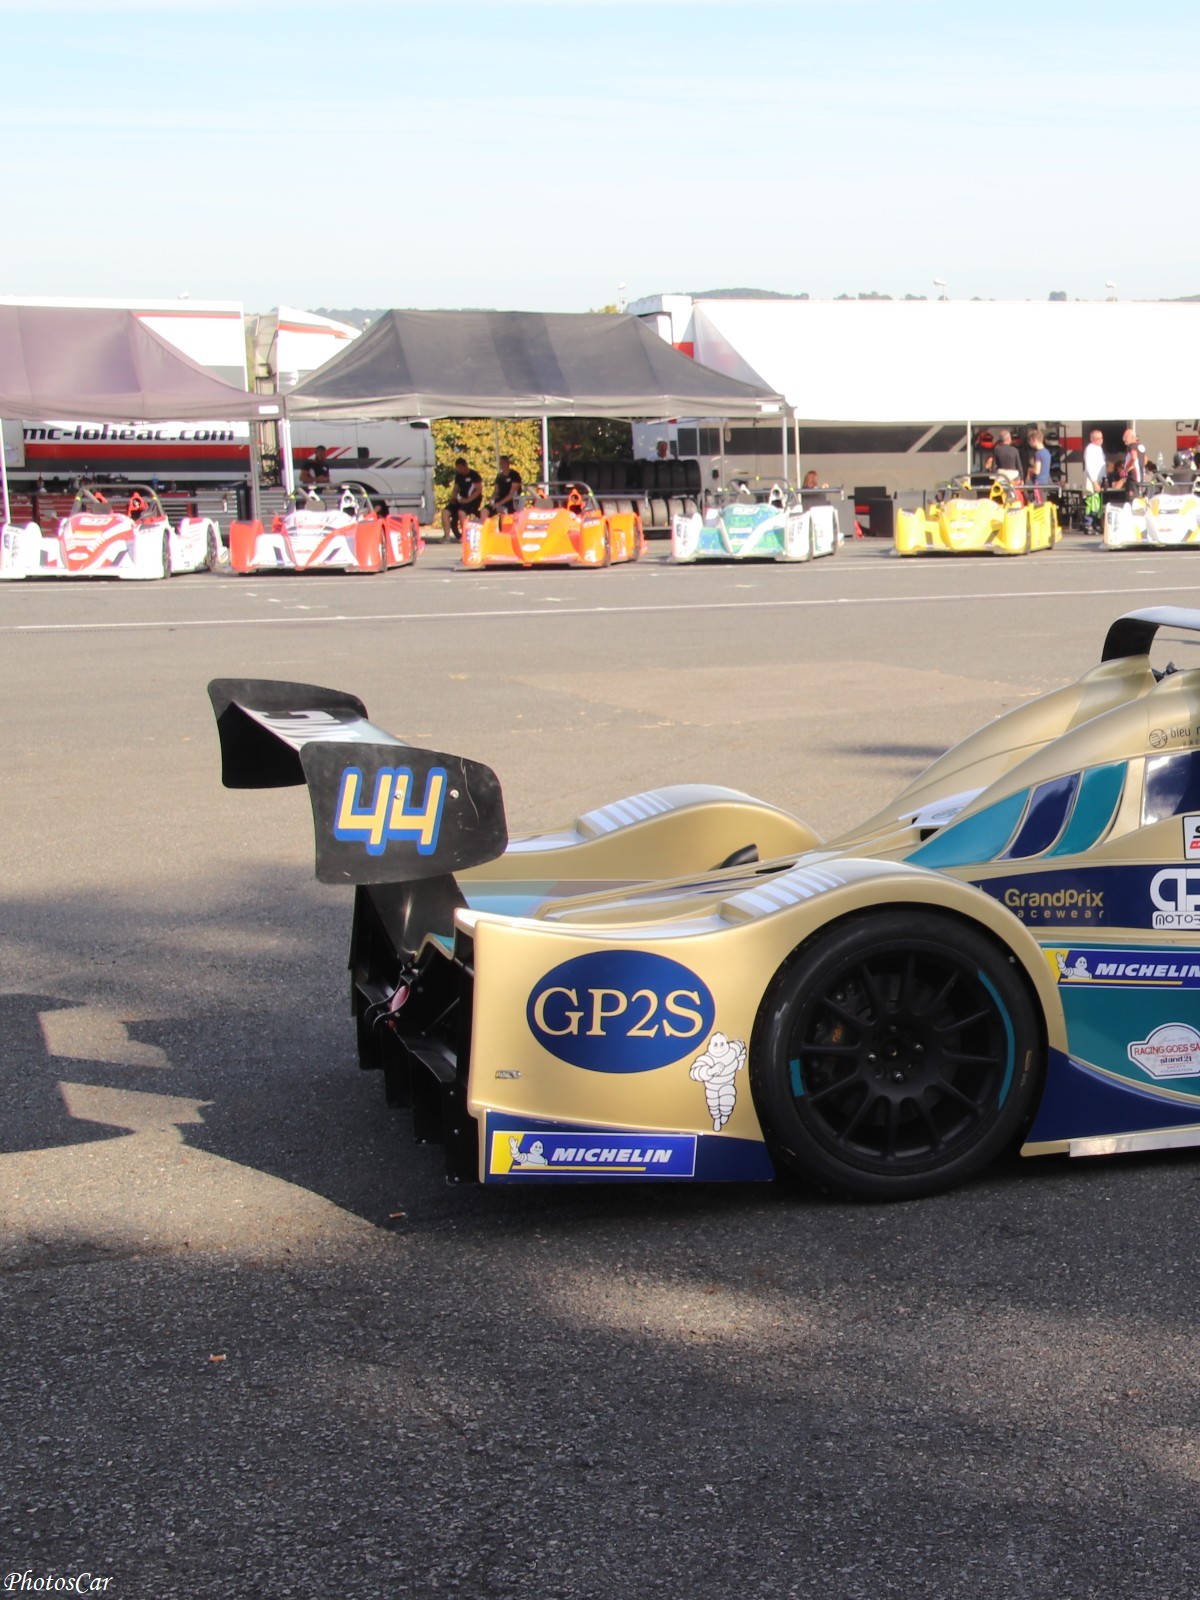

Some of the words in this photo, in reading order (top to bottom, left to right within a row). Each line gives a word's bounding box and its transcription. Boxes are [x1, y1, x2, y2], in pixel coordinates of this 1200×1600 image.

[1170, 728, 1190, 738] bleu
[335, 768, 447, 855] 44
[1004, 888, 1104, 907] GrandPrix
[1017, 909, 1104, 918] acewear
[534, 986, 704, 1038] GP2S
[1134, 1045, 1165, 1056] RACING
[1165, 1044, 1189, 1054] GOES
[551, 1147, 673, 1163] MICHELIN
